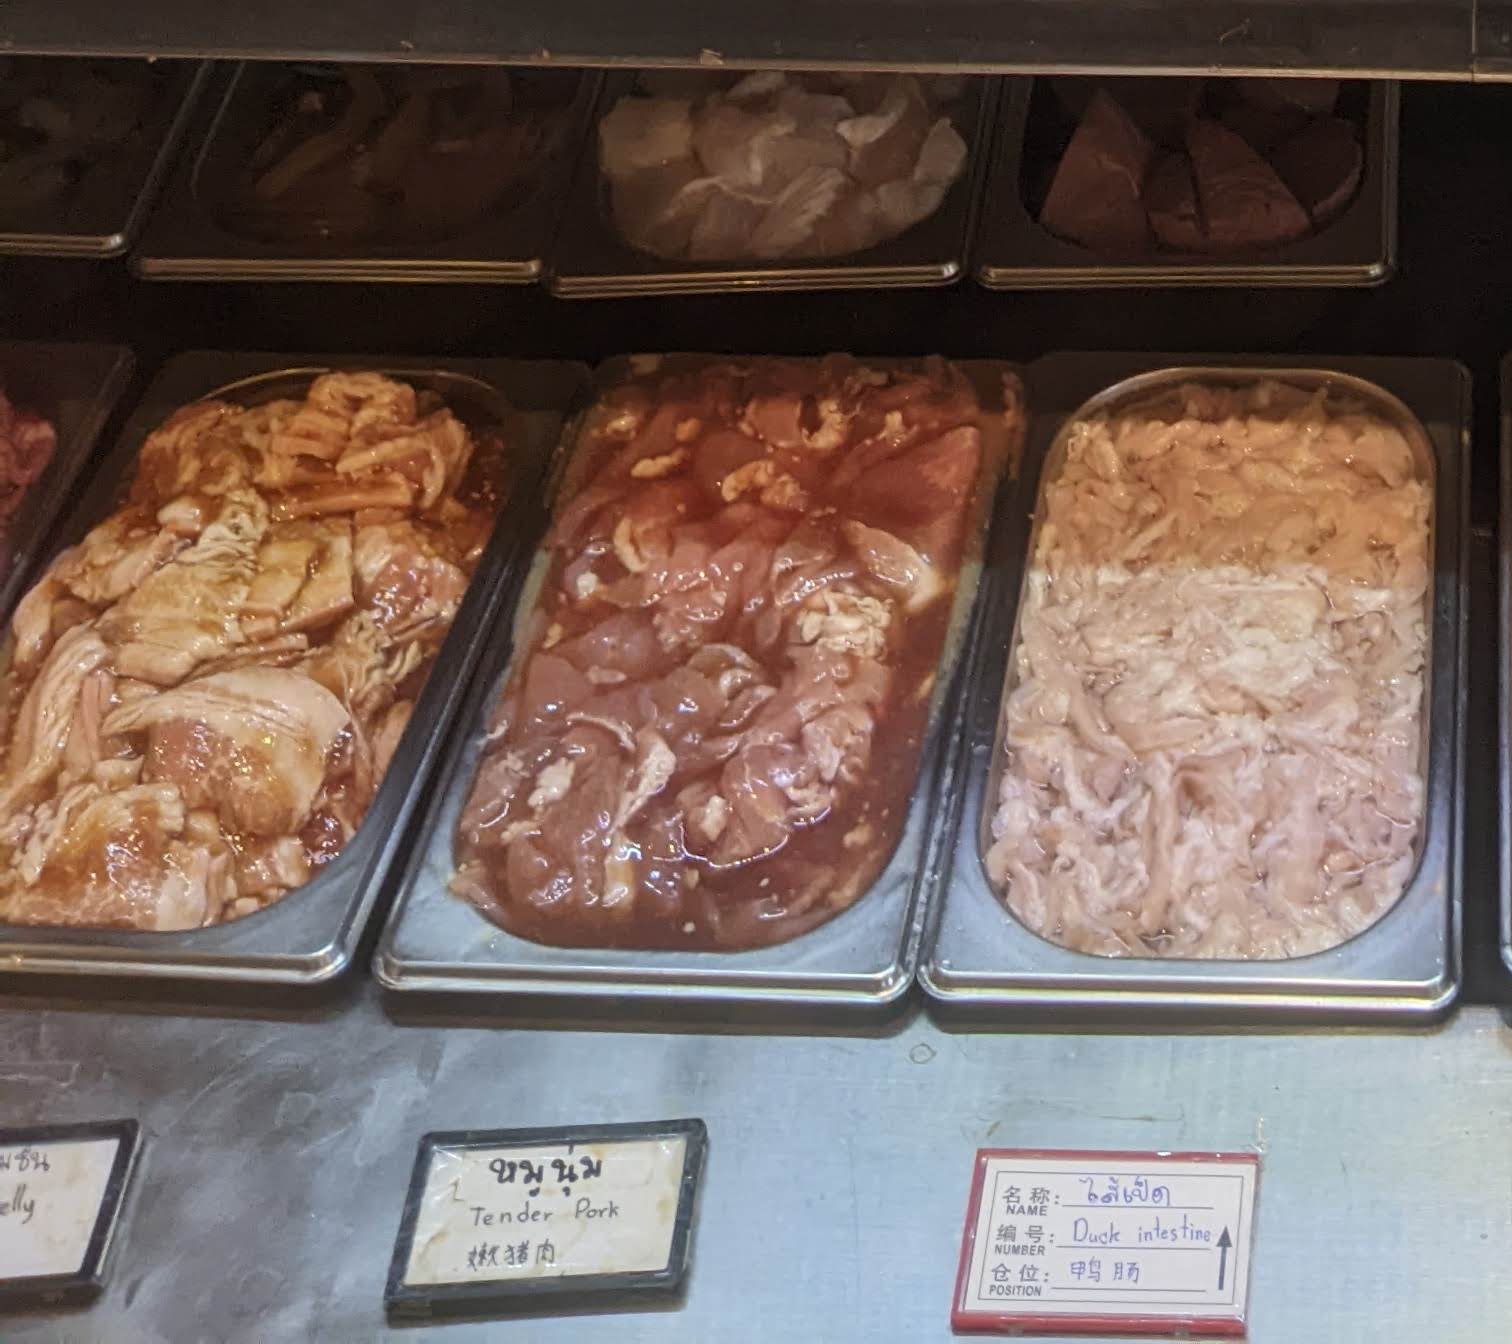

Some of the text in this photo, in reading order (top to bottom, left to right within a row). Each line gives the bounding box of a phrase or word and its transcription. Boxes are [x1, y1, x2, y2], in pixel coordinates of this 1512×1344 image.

[469, 1197, 620, 1227] Tender Pork
[1005, 1204, 1048, 1217] NAME
[1072, 1214, 1212, 1244] Duck intestine
[994, 1244, 1046, 1257] NUMBER
[988, 1284, 1043, 1297] POSITION
